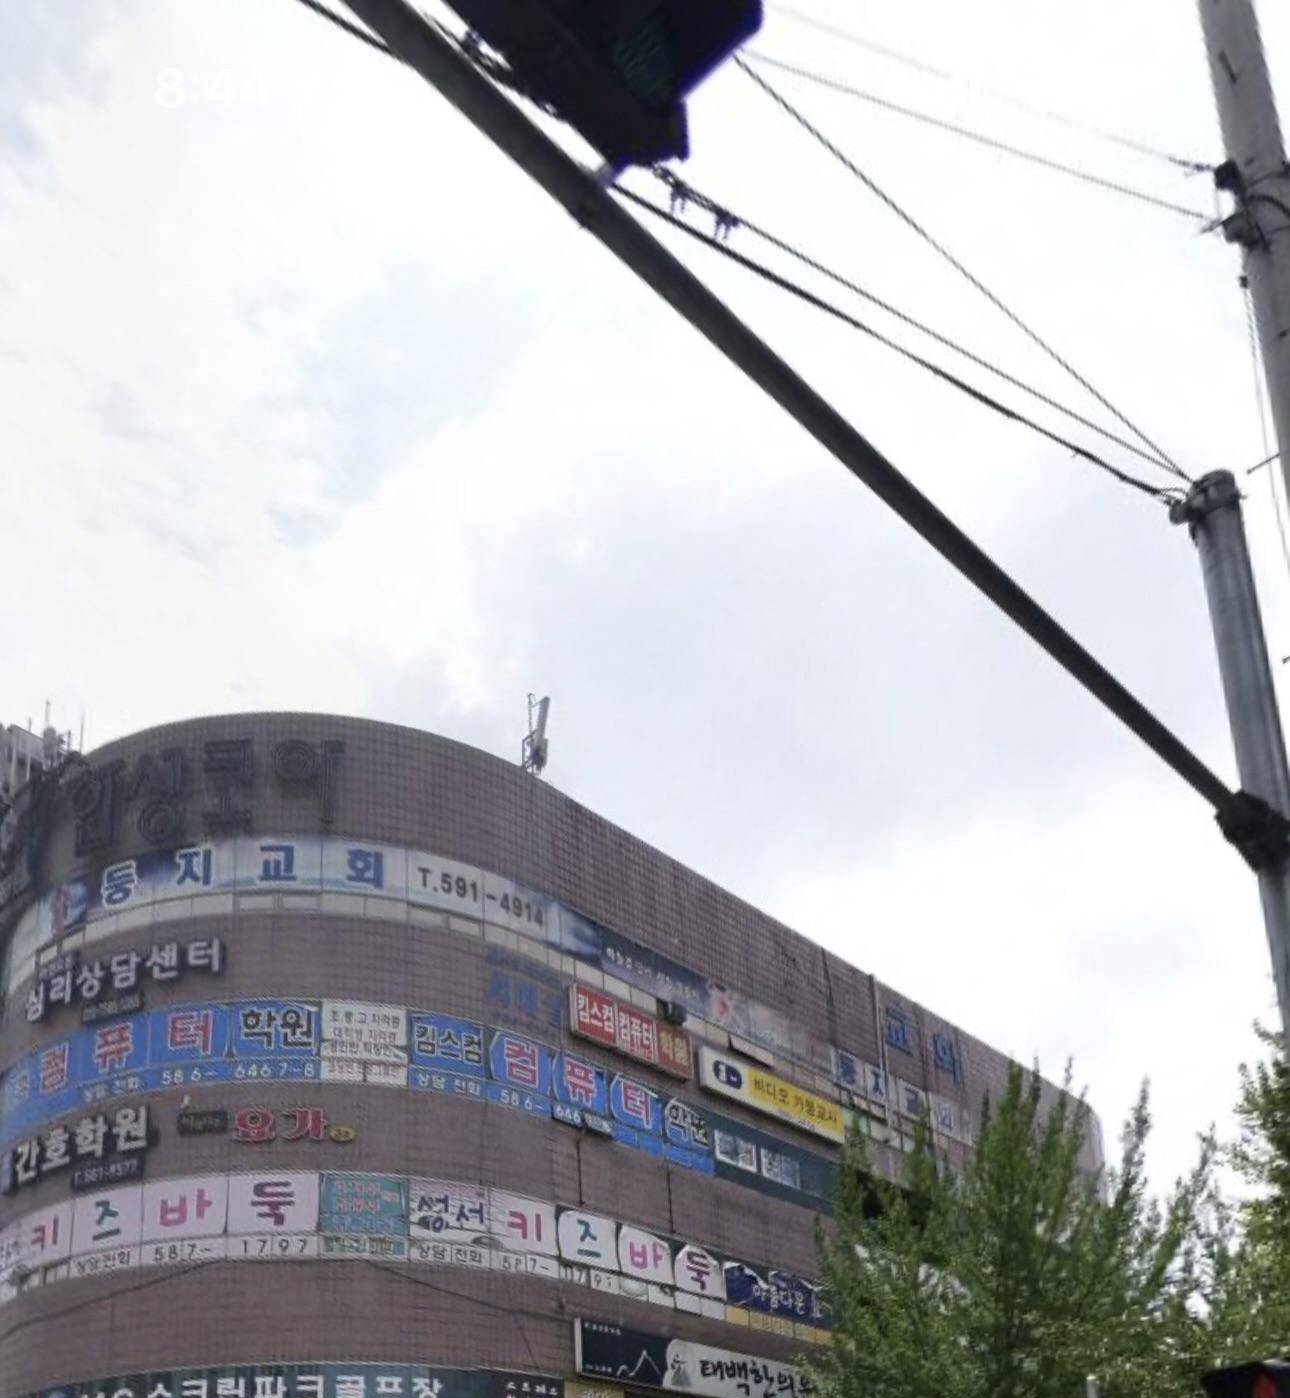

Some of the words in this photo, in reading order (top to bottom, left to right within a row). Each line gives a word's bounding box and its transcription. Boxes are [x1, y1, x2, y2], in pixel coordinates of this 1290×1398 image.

[101, 843, 386, 907] 둥지교회
[417, 866, 546, 928] T.591-4914
[26, 937, 221, 1022] 심리상담센터
[241, 1007, 315, 1049] 학원
[577, 993, 616, 1033] 킴스컴
[618, 1010, 655, 1050] 컴퓨터
[414, 1024, 484, 1066] 킴스컴
[504, 1036, 654, 1130] 컴퓨터
[16, 1105, 148, 1184] 간호학원
[233, 1106, 328, 1143] 요가
[31, 1180, 295, 1249] 키즈바둑
[417, 1194, 485, 1233] 성서
[507, 1210, 711, 1292] 키즈바둑
